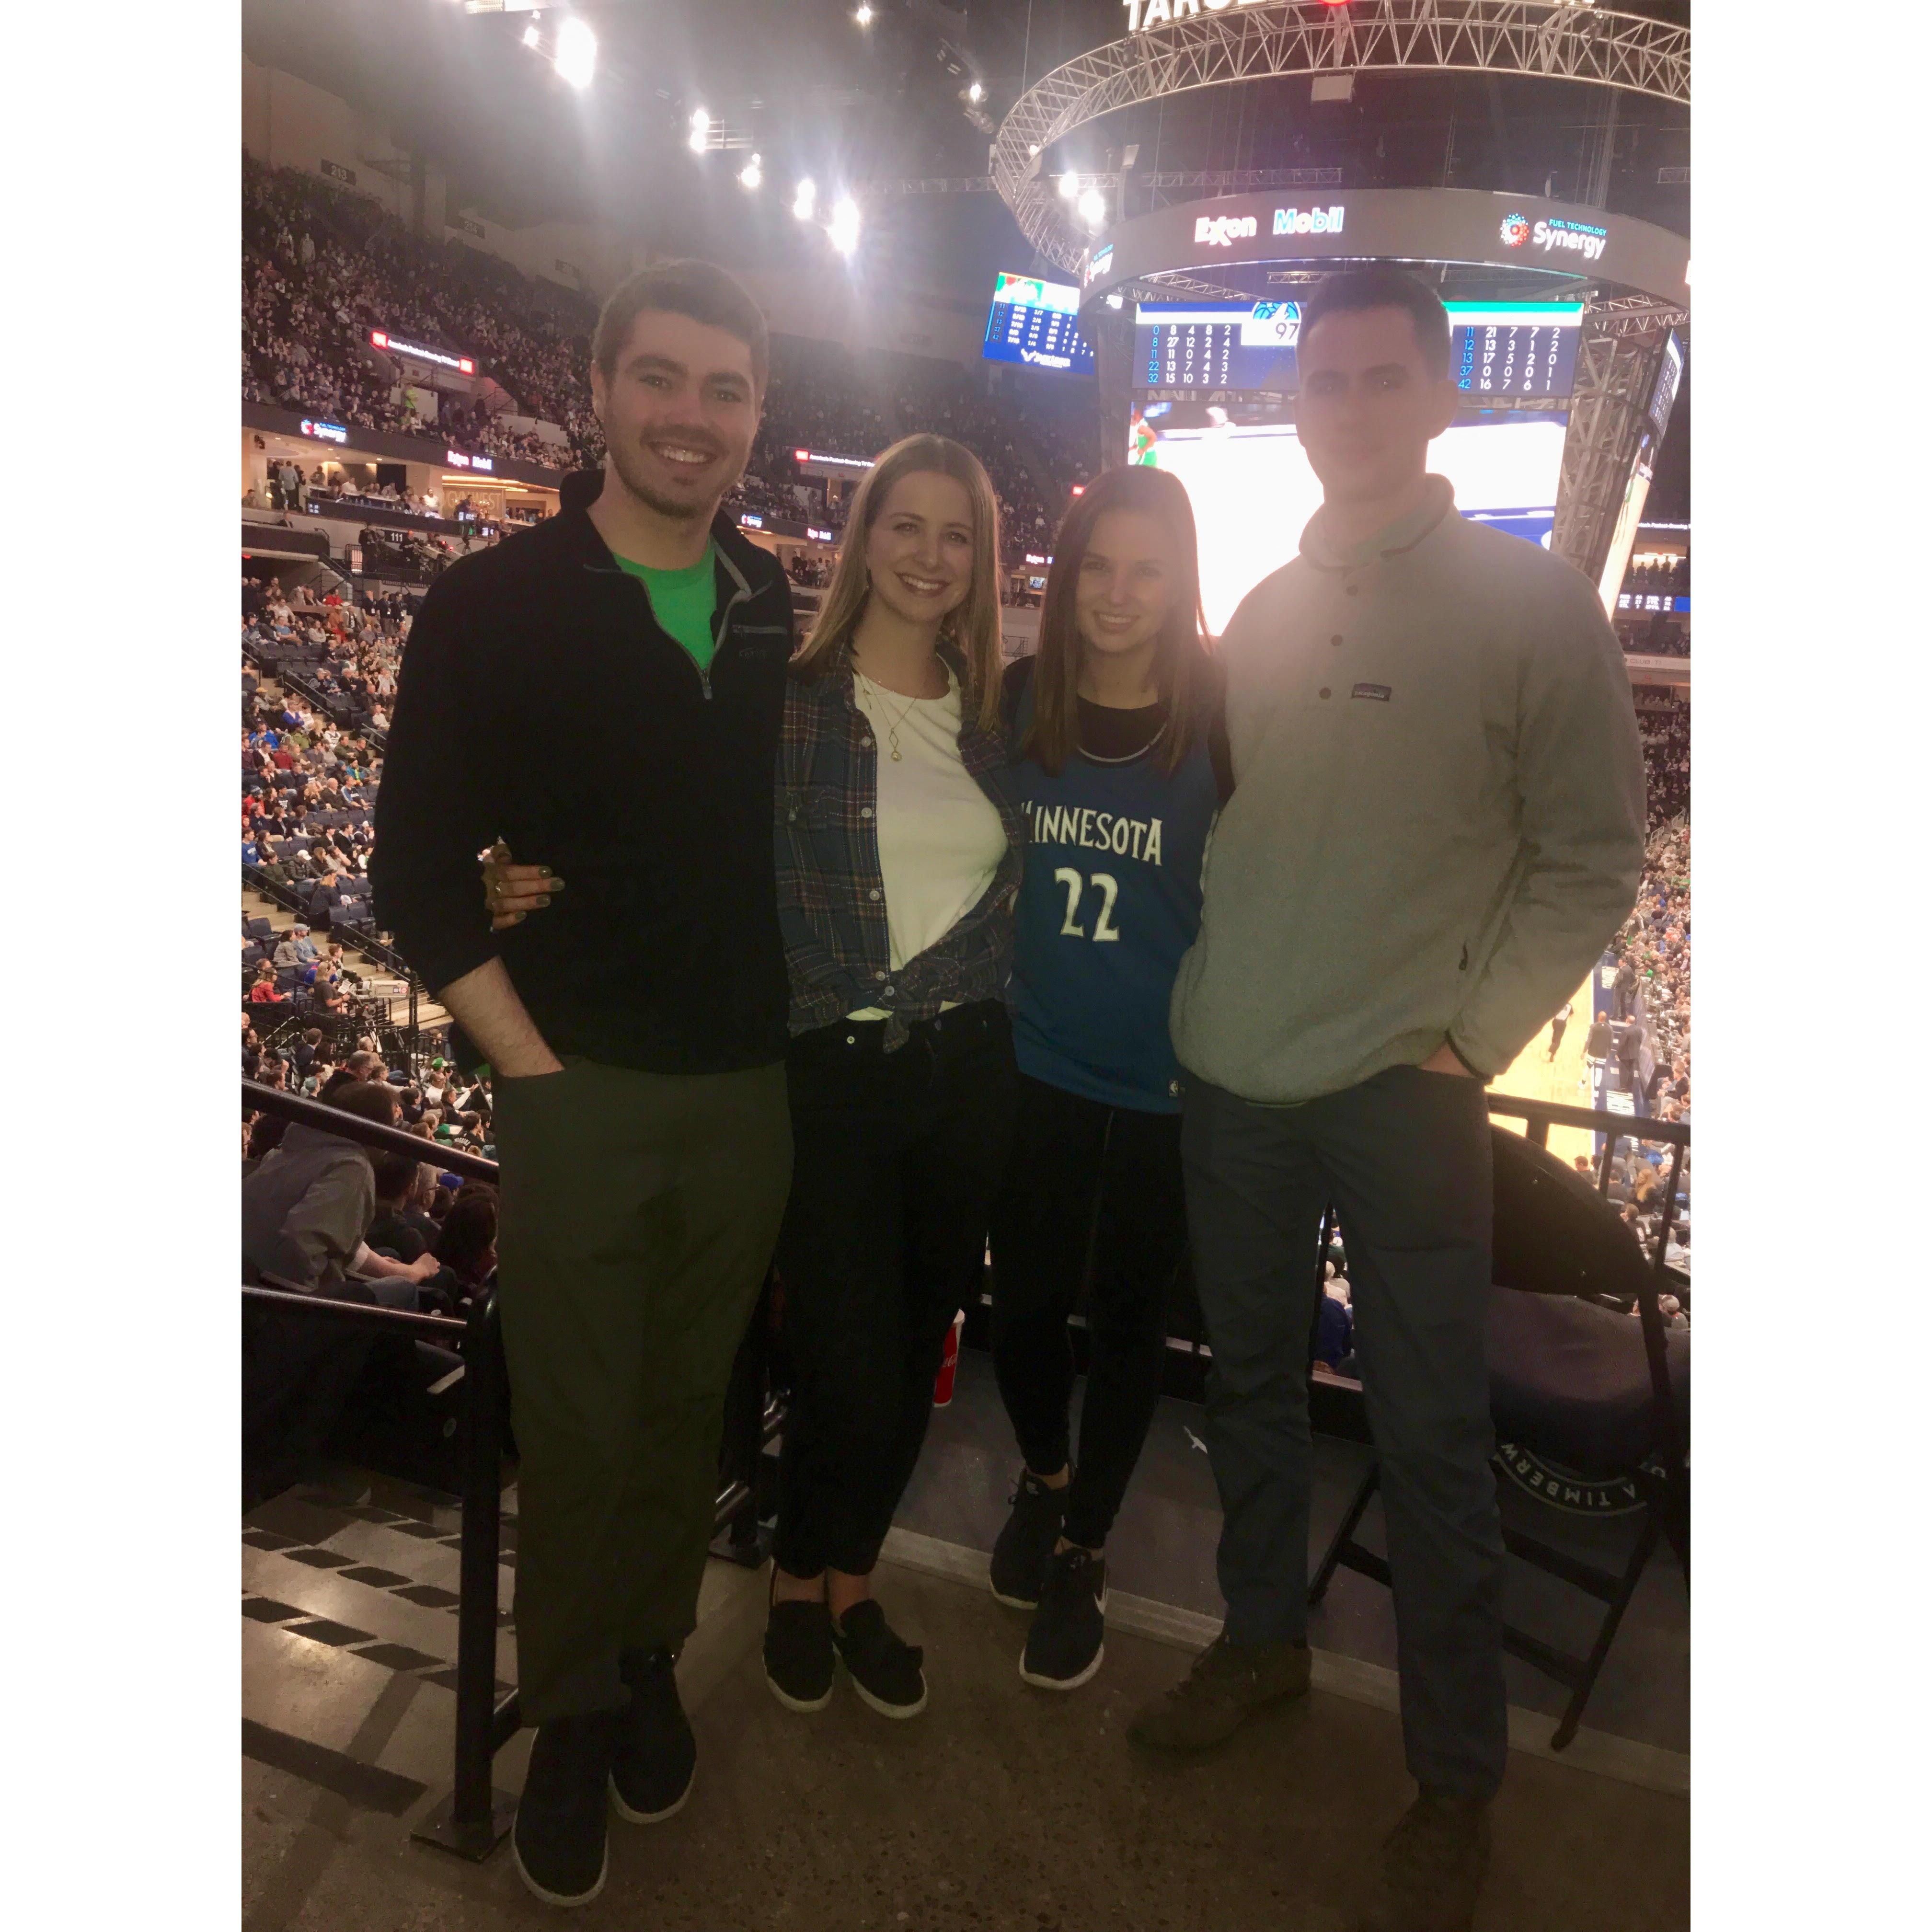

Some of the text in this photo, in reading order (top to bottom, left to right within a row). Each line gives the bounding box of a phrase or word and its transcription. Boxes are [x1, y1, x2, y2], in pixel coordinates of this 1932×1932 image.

[1195, 207, 1345, 246] Exxon Mobil
[1549, 219, 1607, 236] FUEL TECHNOLOGY
[1533, 222, 1606, 259] Synergy
[1153, 325, 1230, 335] 0 8 4 8 2
[1275, 322, 1300, 340] 97
[1467, 327, 1560, 338] 11 21 7 7 2
[1152, 337, 1230, 347] 8 27 12 2 4
[1465, 340, 1558, 351] 12 13 3 1 2
[1151, 349, 1229, 359] 11 11 0 4 2
[1463, 353, 1556, 365] 13 17 5 2 0
[1149, 361, 1228, 371] 22 13 7 4 3
[1460, 366, 1552, 378] 37 0 0 0 1
[1148, 373, 1227, 384] 32 15 10 3 2
[1458, 379, 1550, 391] 42 16 7 6 1
[314, 423, 345, 442] Synergy
[391, 532, 402, 542] 111
[1055, 867, 1120, 942] 22
